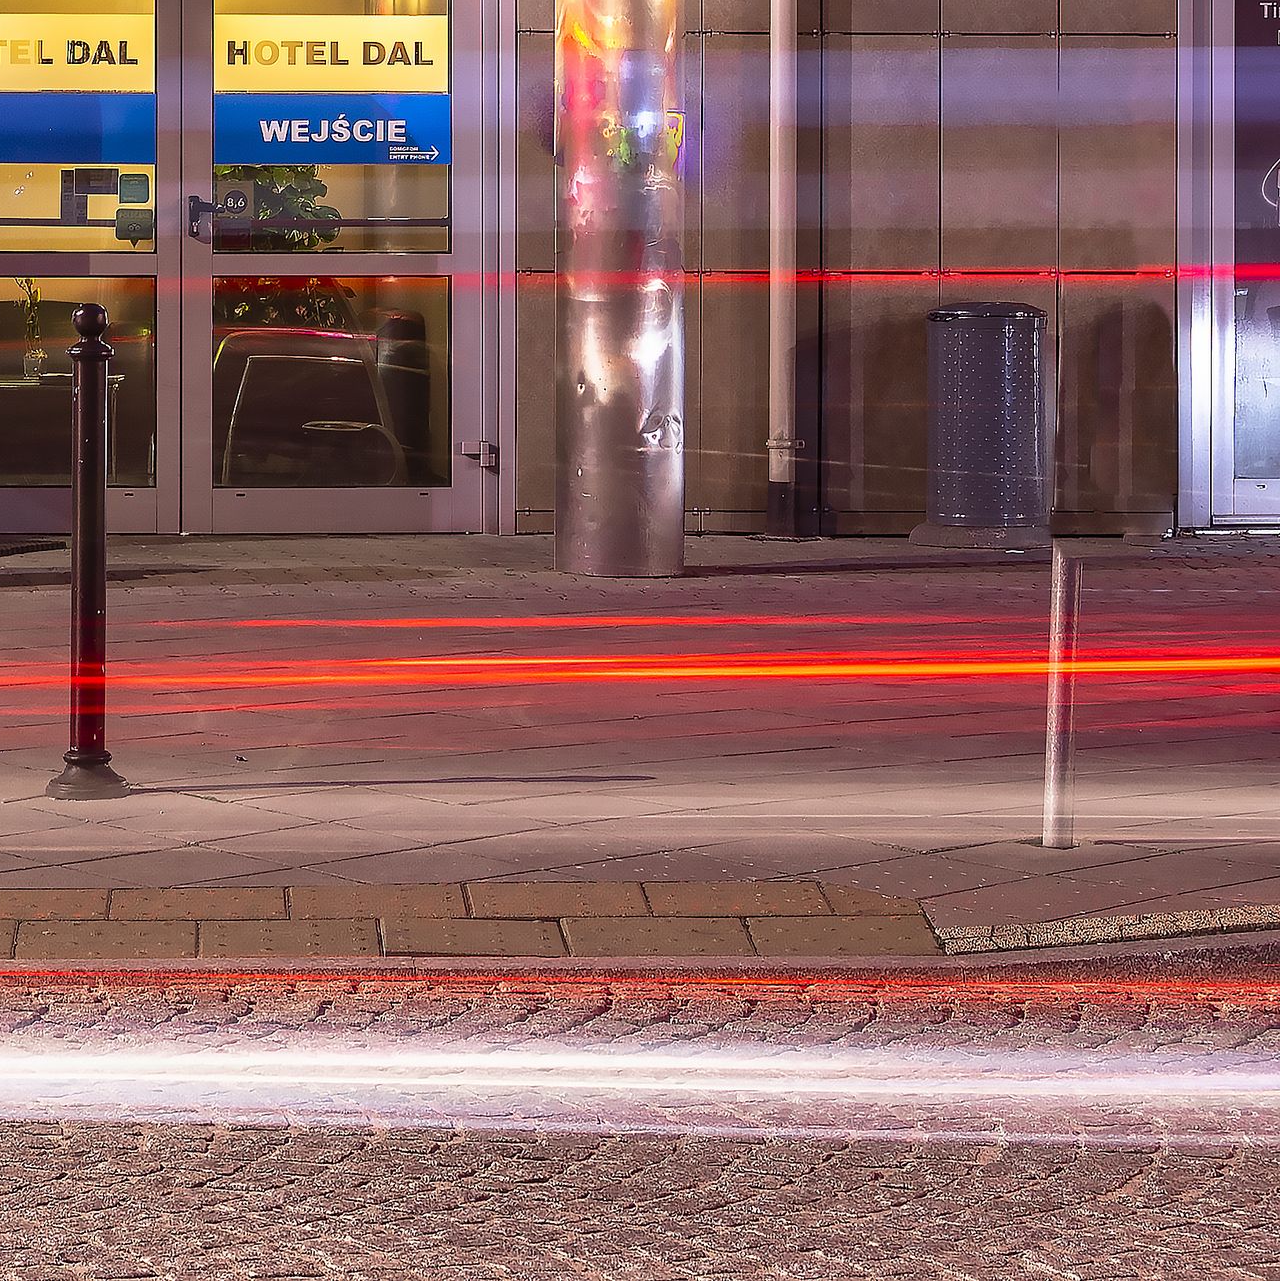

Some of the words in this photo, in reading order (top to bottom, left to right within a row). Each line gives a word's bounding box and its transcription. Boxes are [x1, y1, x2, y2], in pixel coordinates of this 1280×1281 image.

[1259, 2, 1280, 19] Ti
[67, 39, 138, 65] DAL
[227, 40, 349, 66] HOTEL
[362, 41, 434, 66] DAL
[259, 113, 407, 142] WEJŚCIE
[226, 197, 245, 209] 8,6
